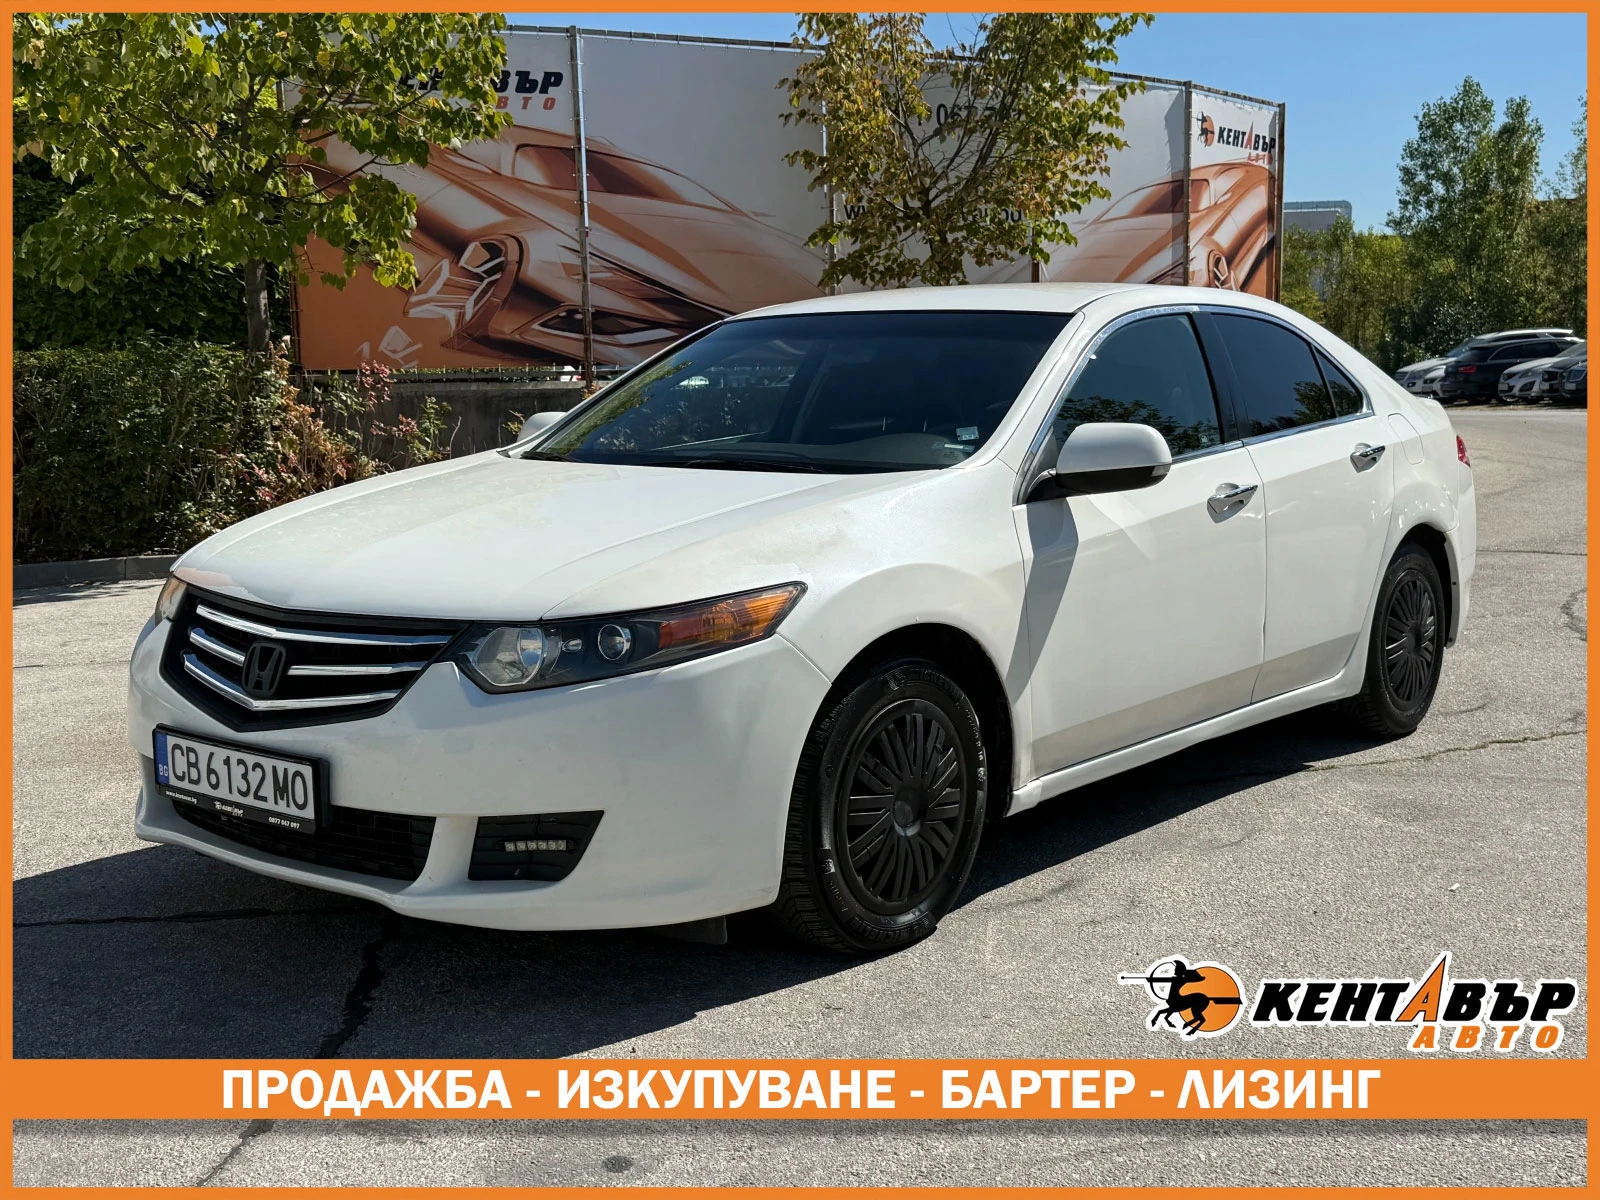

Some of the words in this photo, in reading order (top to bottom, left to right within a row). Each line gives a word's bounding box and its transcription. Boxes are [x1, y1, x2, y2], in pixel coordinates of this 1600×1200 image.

[494, 96, 557, 111] ВТО
[1217, 120, 1276, 154] КЕНТАВЪР
[159, 764, 169, 777] BG
